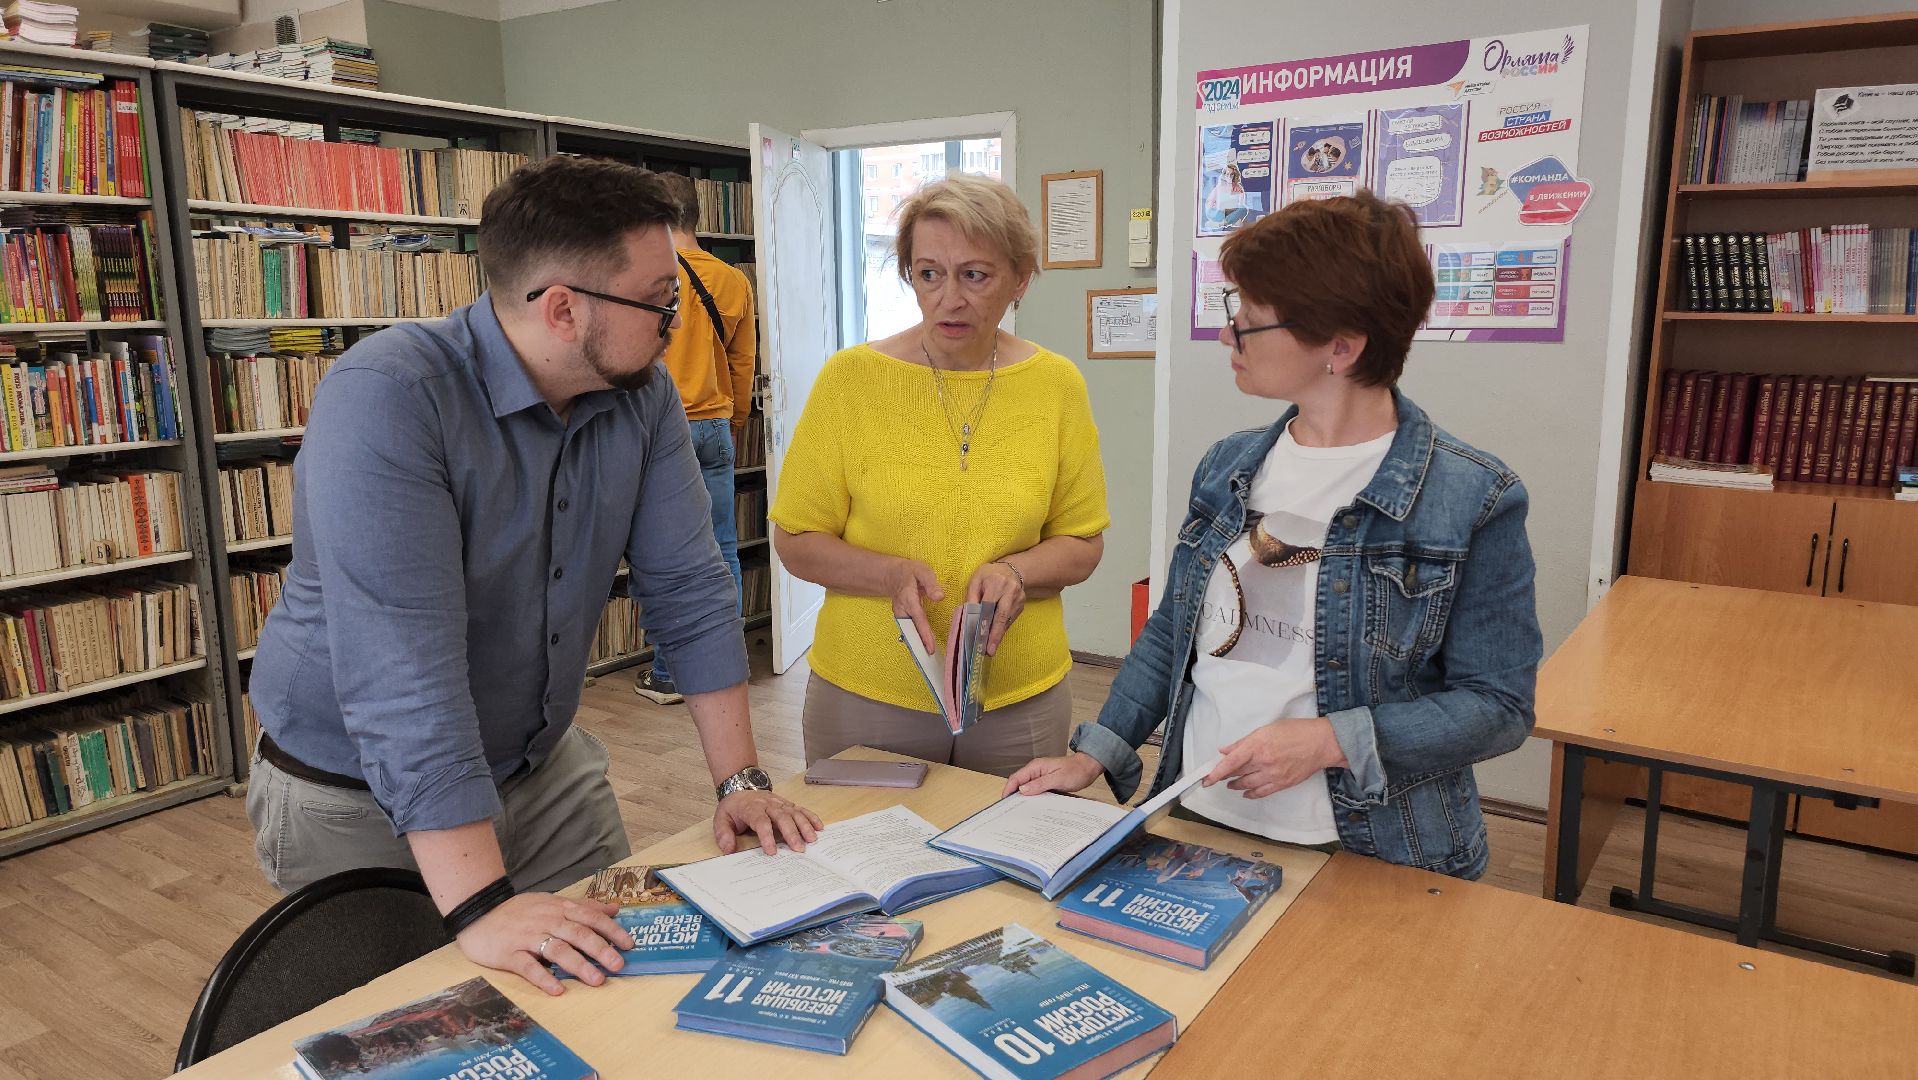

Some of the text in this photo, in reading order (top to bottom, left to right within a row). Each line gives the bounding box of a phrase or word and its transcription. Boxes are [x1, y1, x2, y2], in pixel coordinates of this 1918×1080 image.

[1483, 39, 1560, 74] Орлята
[1243, 54, 1413, 94] ИНФОРМАЦИЯ
[1502, 64, 1559, 78] РОССИИ
[1205, 79, 1240, 101] 2024
[1499, 102, 1541, 116] РОССИЯ
[1506, 114, 1547, 127] СТРАНА
[1481, 121, 1567, 141] ВОЗМОЖНОСТЕЙ
[1510, 172, 1569, 184] #КОМАНДА
[1202, 602, 1314, 644] CALMNESS
[1082, 884, 1124, 907] 11
[653, 914, 703, 925] ВЕКОВ
[1121, 902, 1200, 932] ИСТОРИЯ
[1132, 894, 1210, 924] РОССИИ
[629, 923, 701, 936] СРЕДНИХ
[630, 931, 699, 946] ИСТОР
[703, 973, 754, 1004] 11
[760, 980, 848, 1004] ИСТОРИЯ
[751, 993, 839, 1016] ВСЕОБЩАЯ
[1033, 990, 1117, 1034] РОССИИ
[1051, 1002, 1136, 1046] ИСТОРИЯ
[993, 1026, 1055, 1065] 10
